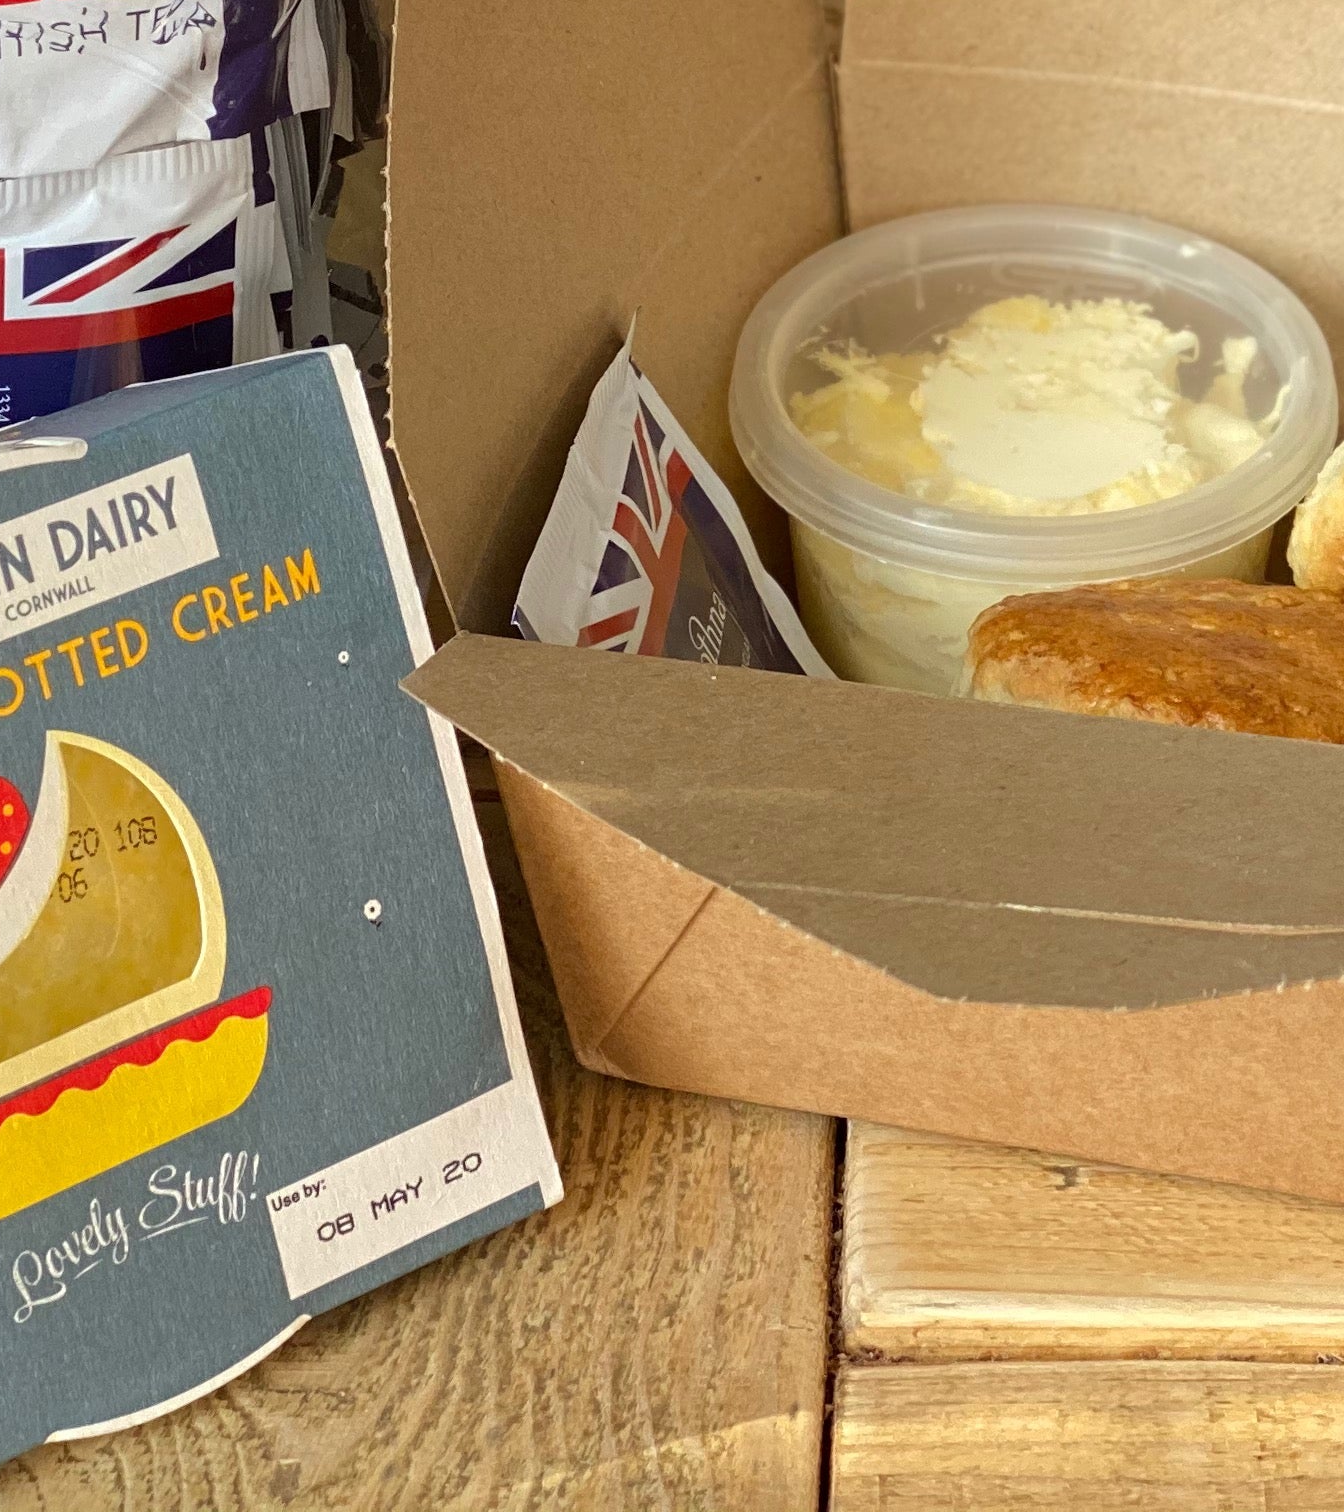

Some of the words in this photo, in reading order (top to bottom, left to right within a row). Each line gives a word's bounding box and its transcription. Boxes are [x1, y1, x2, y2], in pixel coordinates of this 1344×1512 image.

[47, 476, 177, 572] DAIRY
[4, 576, 95, 622] CORNWALL
[171, 548, 322, 643] CREAM
[68, 827, 100, 862] 20
[57, 867, 88, 903] 06
[271, 1191, 301, 1212] Use
[305, 1179, 327, 1199] by:
[316, 1212, 355, 1242] 08
[370, 1176, 423, 1220] MAY
[442, 1152, 482, 1184] 20
[12, 1198, 129, 1324] Lovely
[139, 1150, 260, 1230] Stuff!
